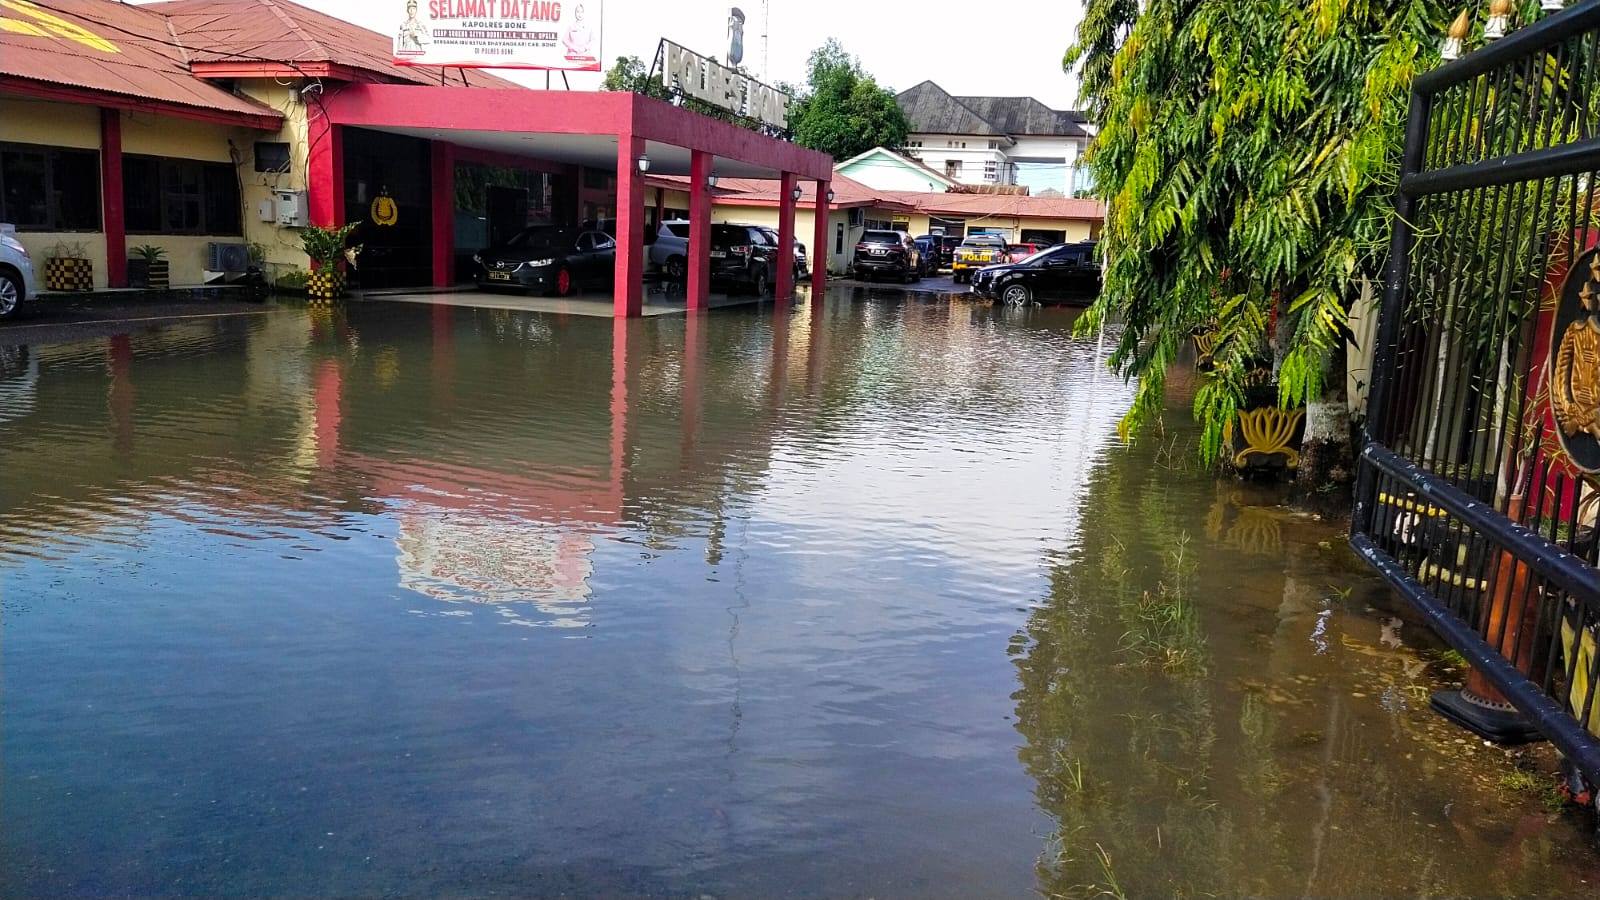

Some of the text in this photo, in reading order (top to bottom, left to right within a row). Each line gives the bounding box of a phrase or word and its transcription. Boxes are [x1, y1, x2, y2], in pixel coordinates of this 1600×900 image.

[429, 0, 561, 21] SELAMAT DATANG
[462, 21, 503, 29] KAPOLRES
[663, 42, 789, 129] POLRES BONE
[961, 254, 992, 262] POLISI
